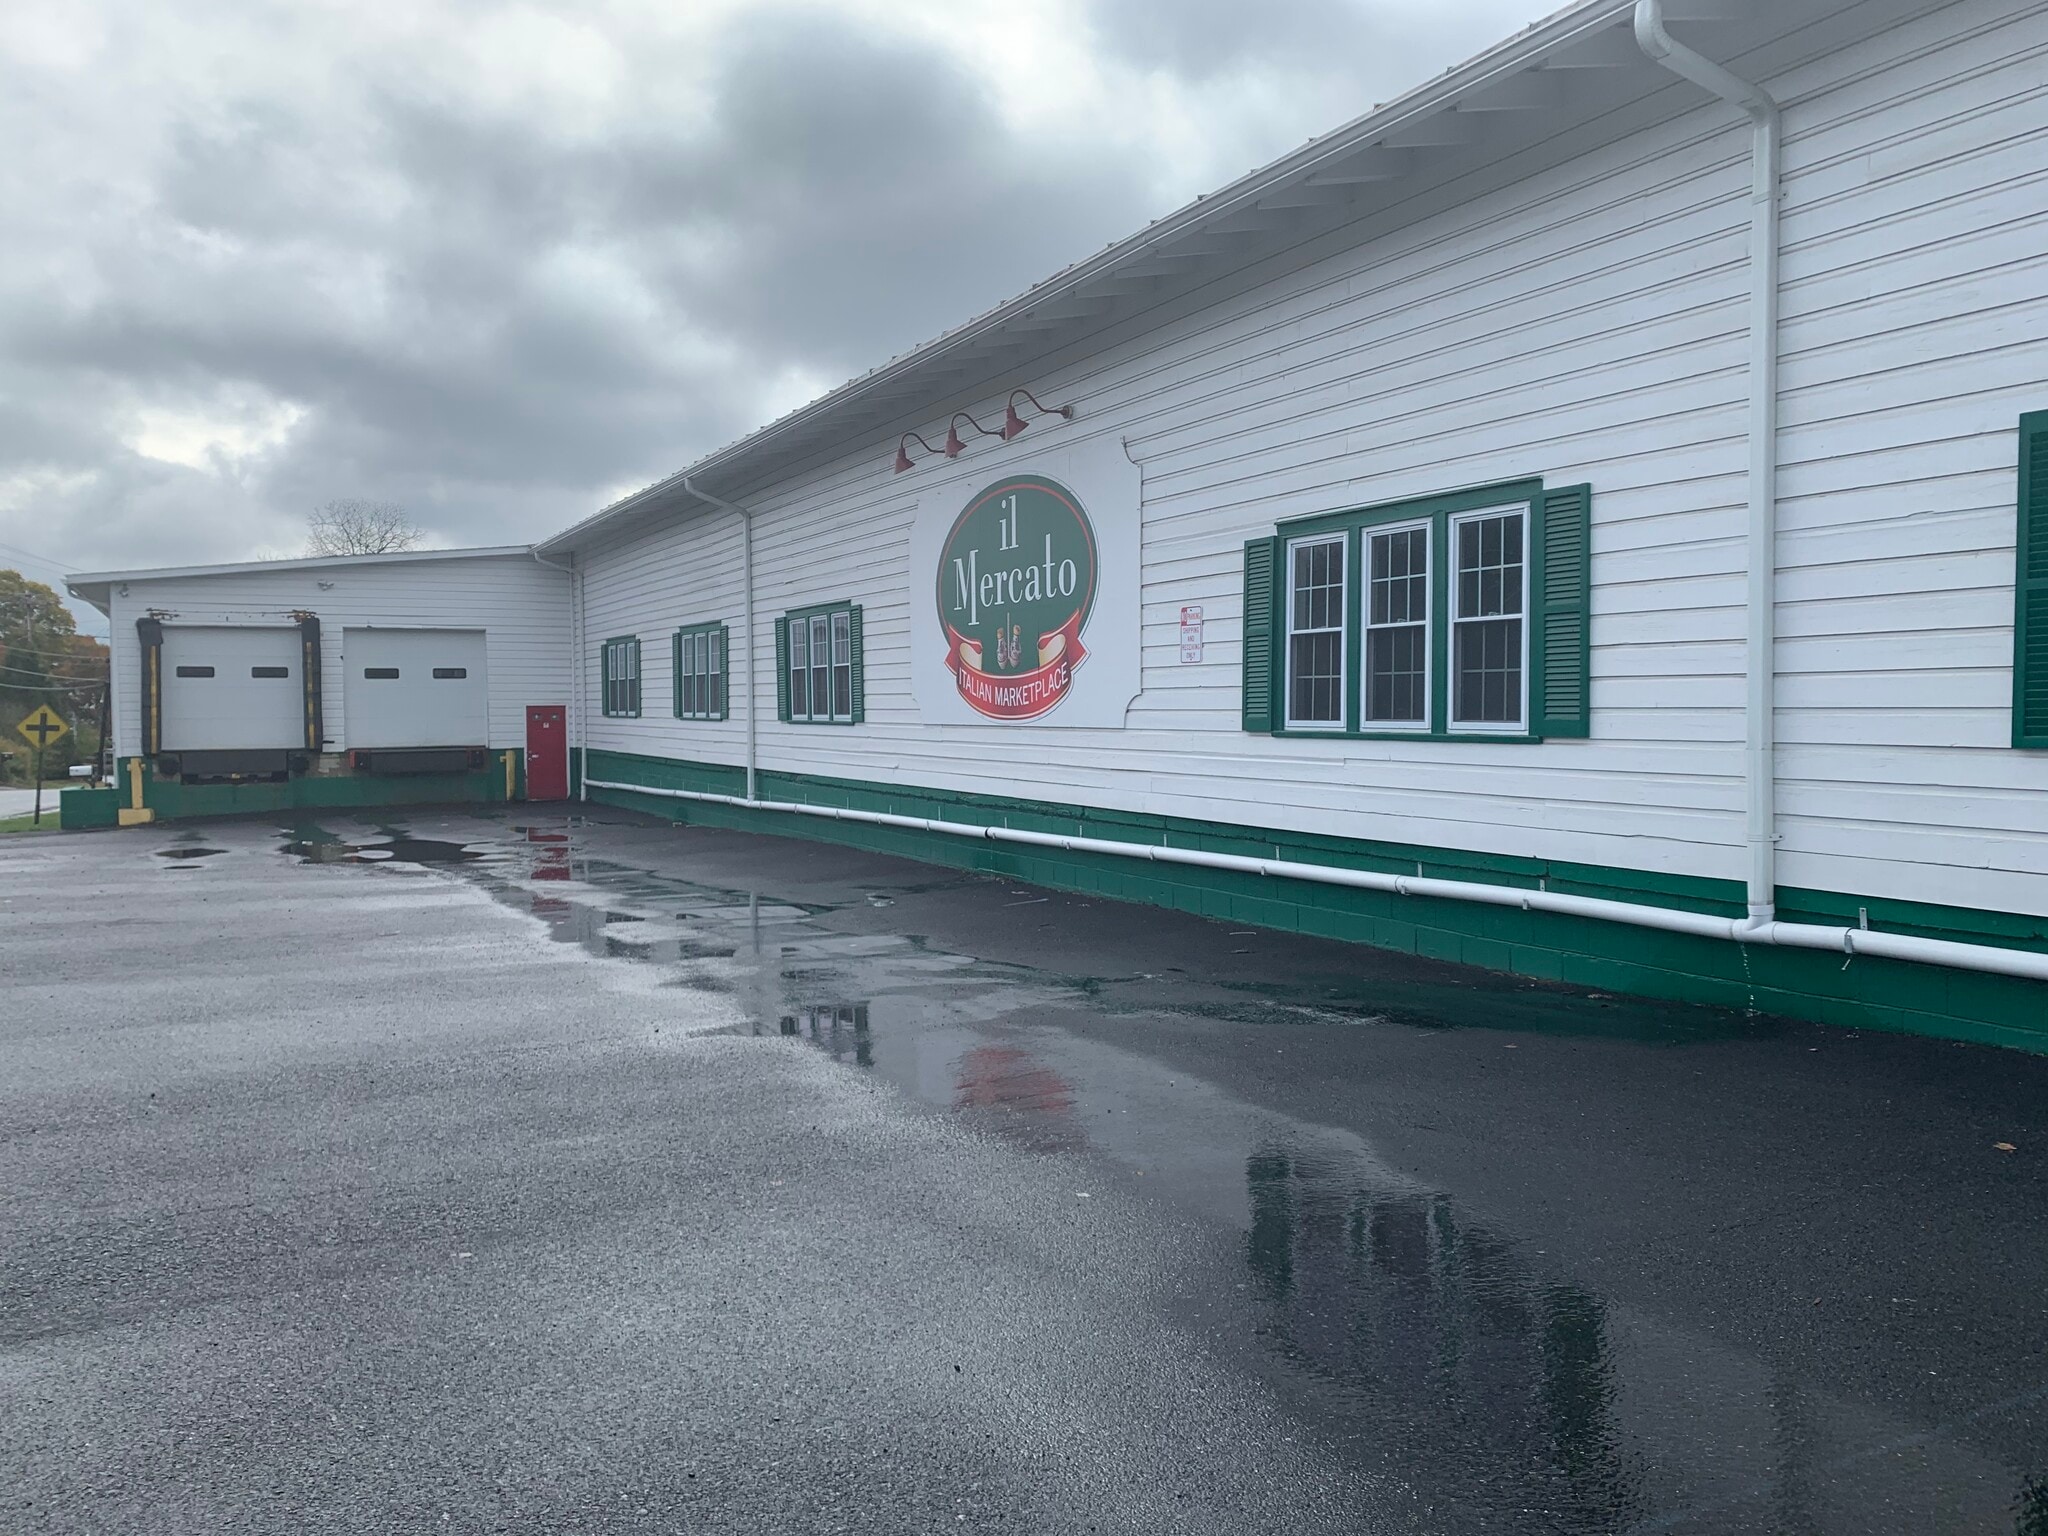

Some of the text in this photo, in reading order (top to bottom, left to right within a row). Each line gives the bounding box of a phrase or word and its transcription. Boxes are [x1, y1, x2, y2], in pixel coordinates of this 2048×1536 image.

[999, 494, 1019, 551] il
[953, 533, 1077, 626] Mercato
[958, 661, 1069, 707] ITALIAN MARKETPLACE
